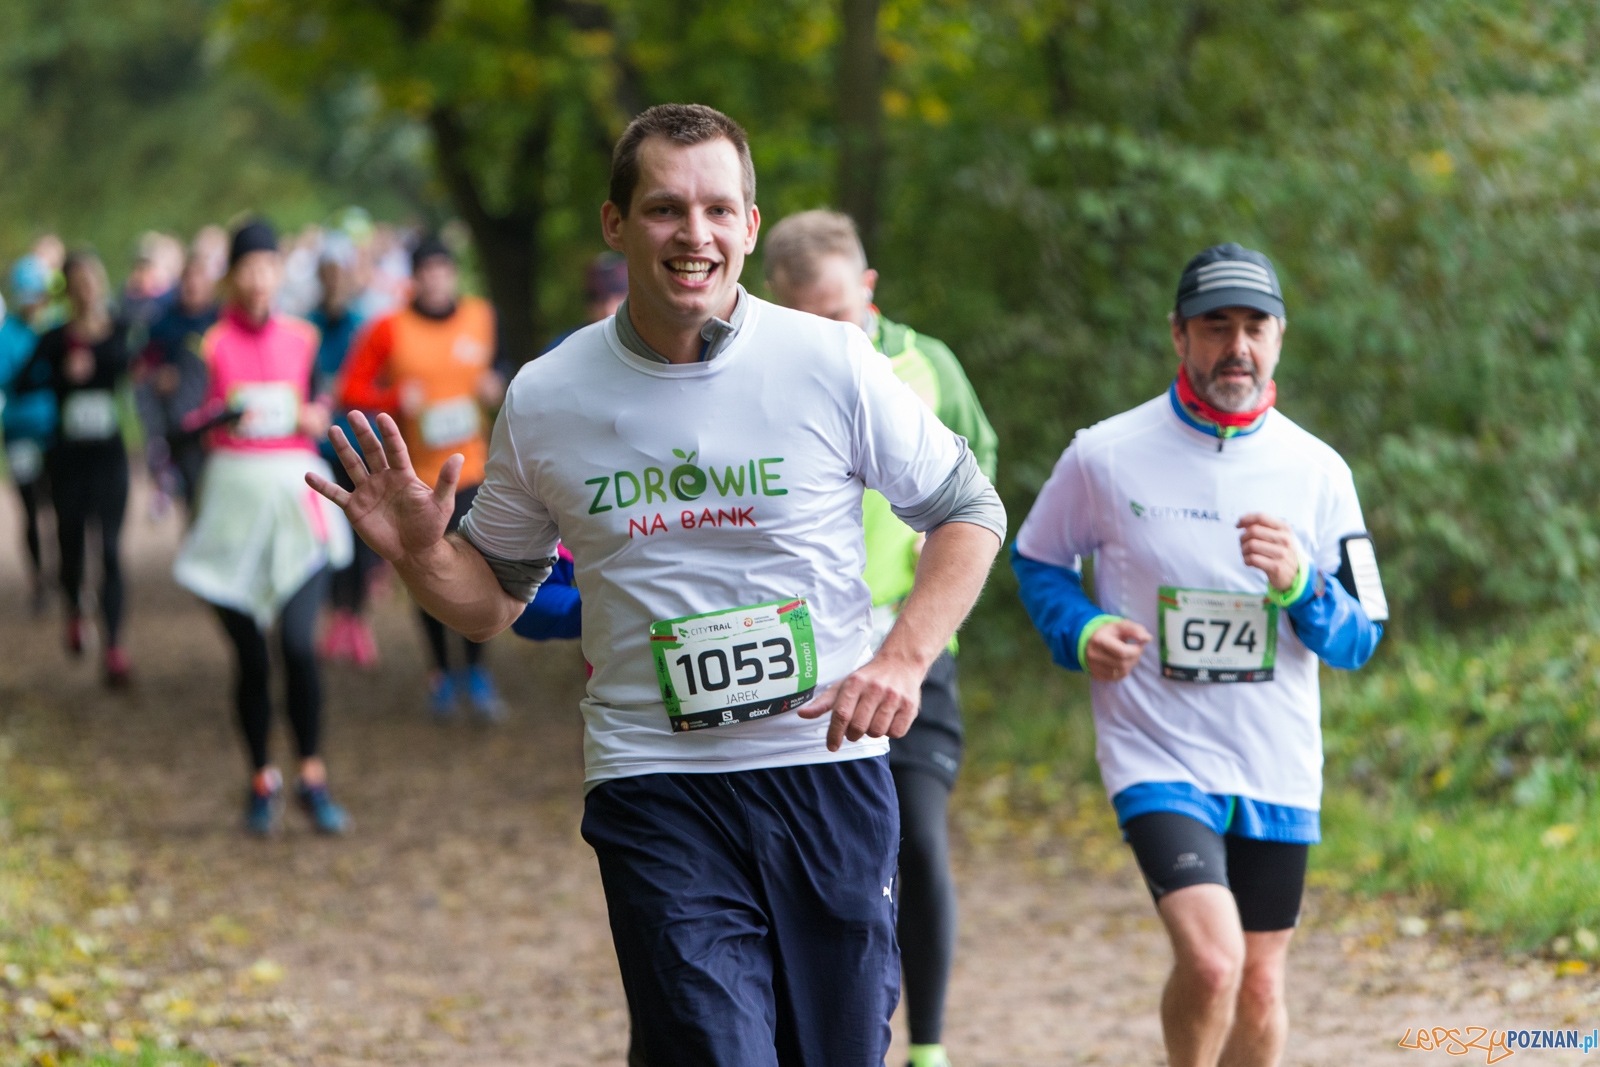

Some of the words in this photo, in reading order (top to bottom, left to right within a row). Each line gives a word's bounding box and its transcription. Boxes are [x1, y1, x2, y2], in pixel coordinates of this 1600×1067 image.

[585, 457, 789, 515] ZDROWIE
[629, 513, 668, 539] NA
[680, 506, 757, 529] BANK
[1183, 618, 1257, 653] 674
[676, 637, 795, 695] 1053
[805, 641, 813, 678] Poznań
[726, 690, 759, 705] JAREK
